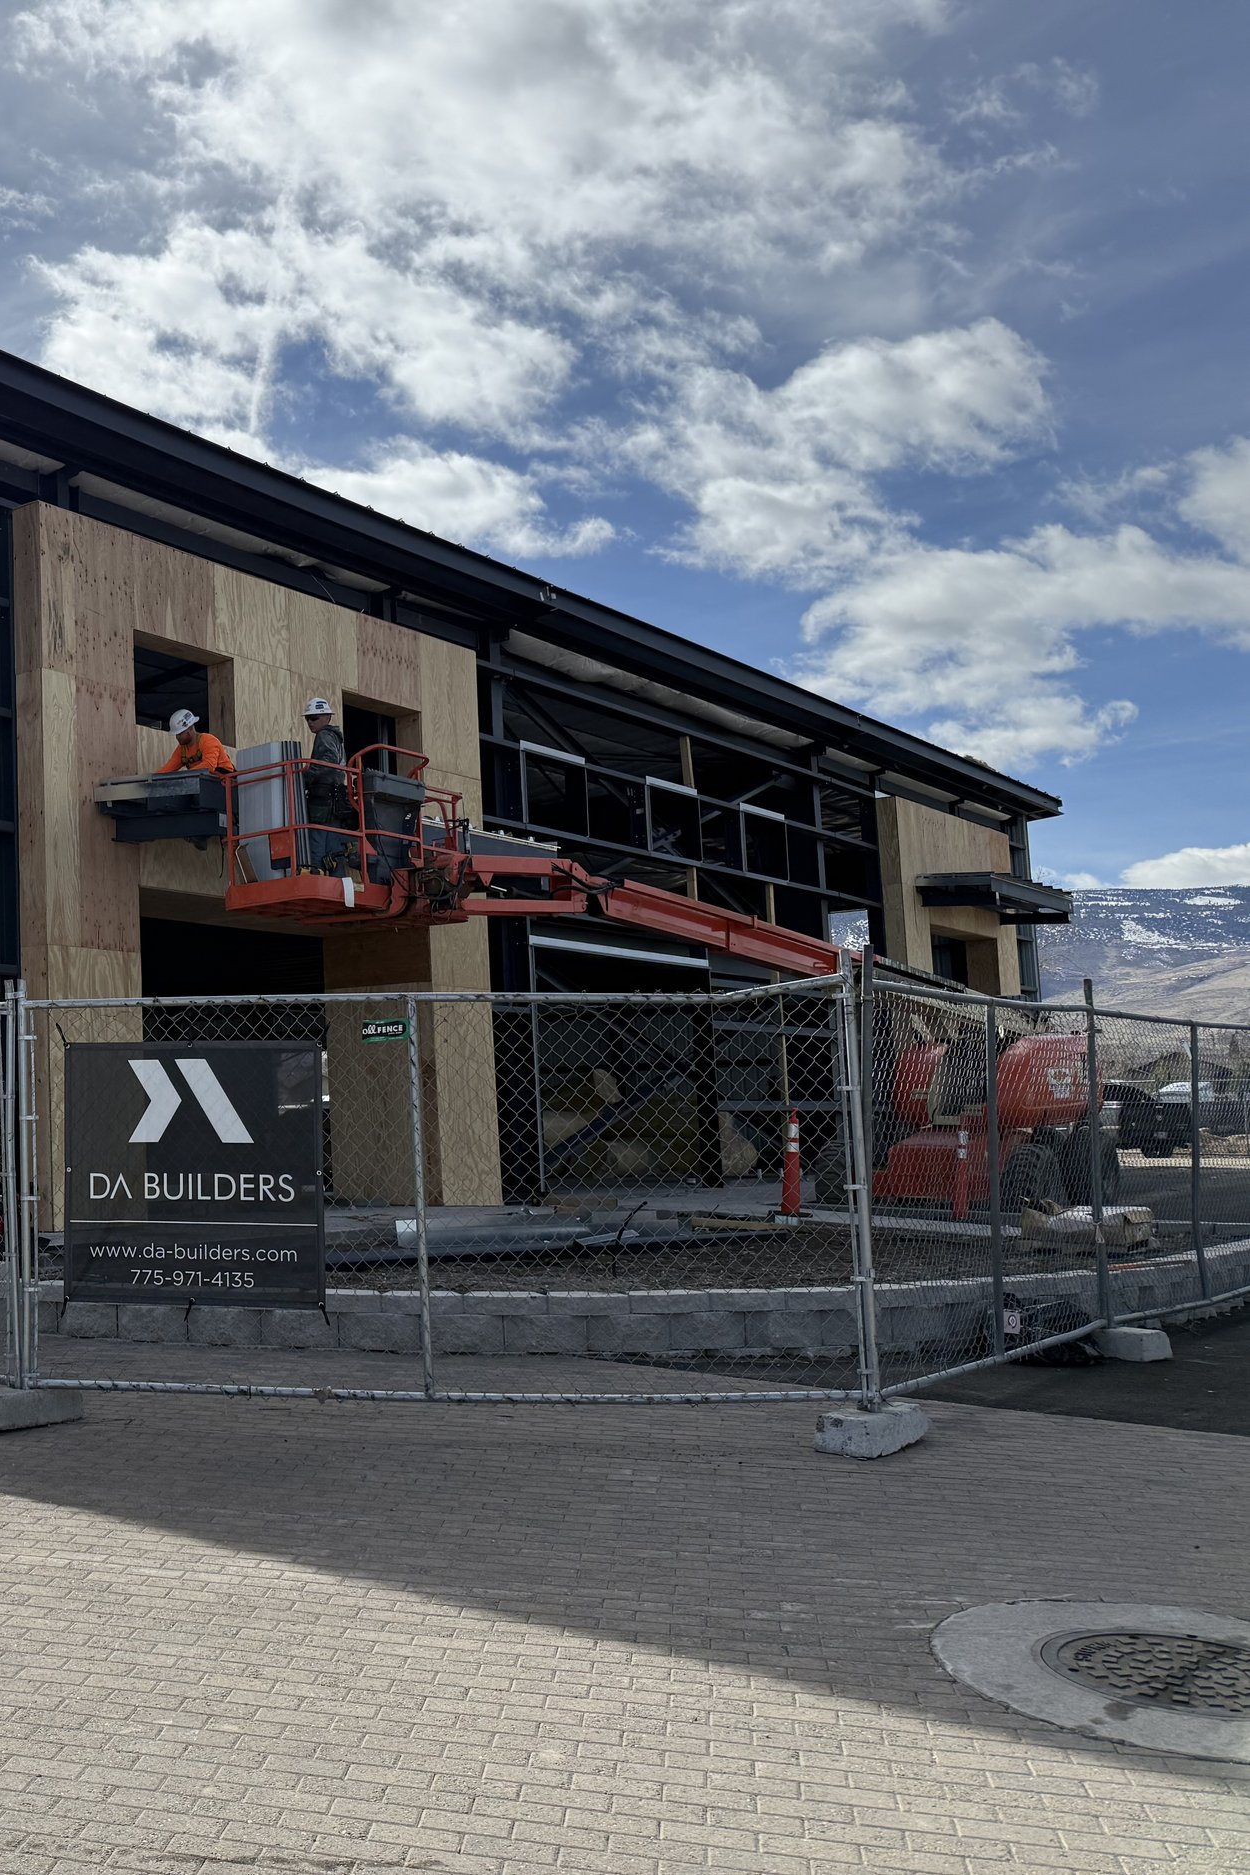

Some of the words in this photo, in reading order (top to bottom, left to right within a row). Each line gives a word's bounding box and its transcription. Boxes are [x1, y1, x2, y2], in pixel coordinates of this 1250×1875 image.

[377, 1024, 403, 1033] FENCE
[89, 1172, 133, 1199] DA
[144, 1173, 295, 1202] BUILDERS
[89, 1243, 298, 1263] www.da-builders.com
[130, 1269, 255, 1288] 775-971-4135
